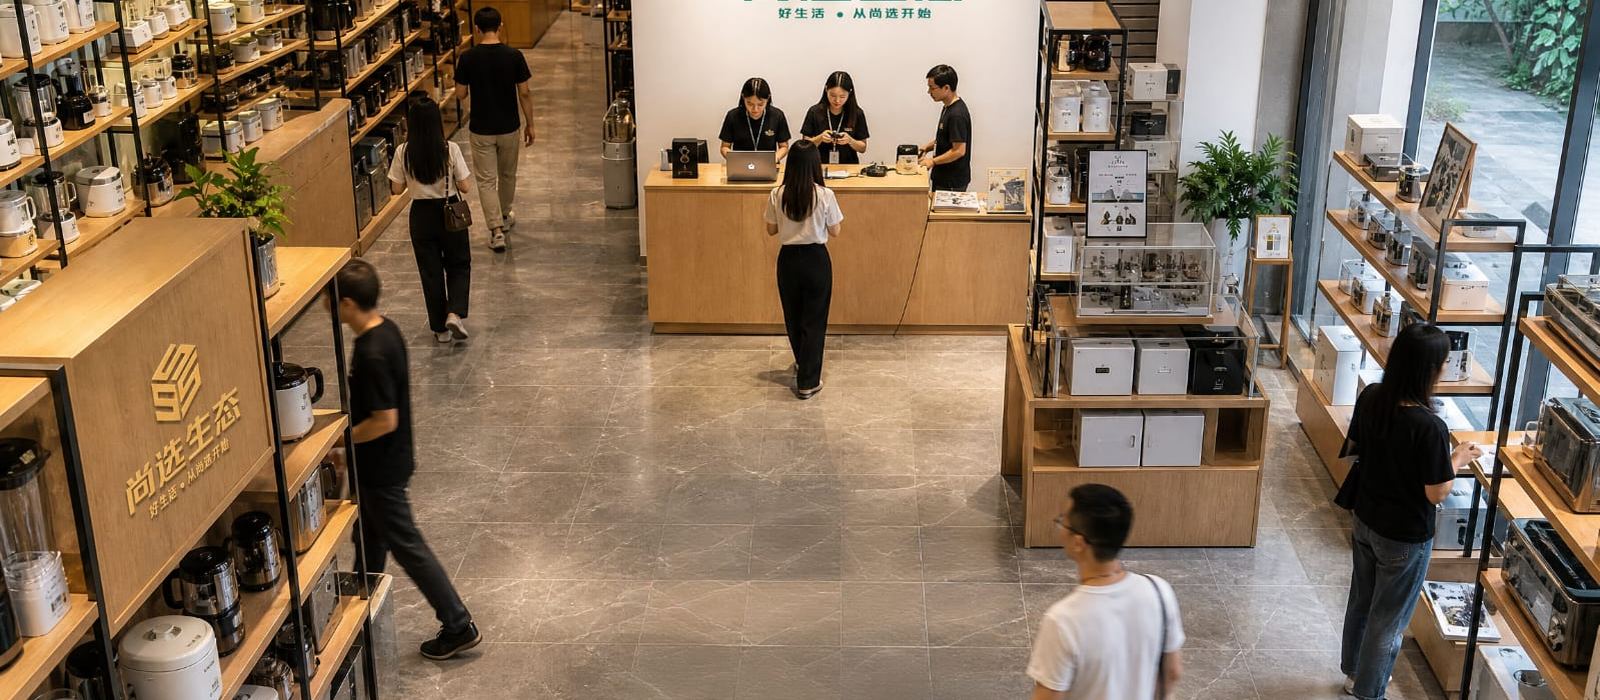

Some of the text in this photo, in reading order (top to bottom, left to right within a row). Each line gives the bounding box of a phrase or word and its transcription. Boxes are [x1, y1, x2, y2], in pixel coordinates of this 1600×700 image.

[778, 7, 932, 19] 好生活 从尚选开始
[126, 386, 241, 516] 尚选生态
[149, 484, 178, 519] 好生活
